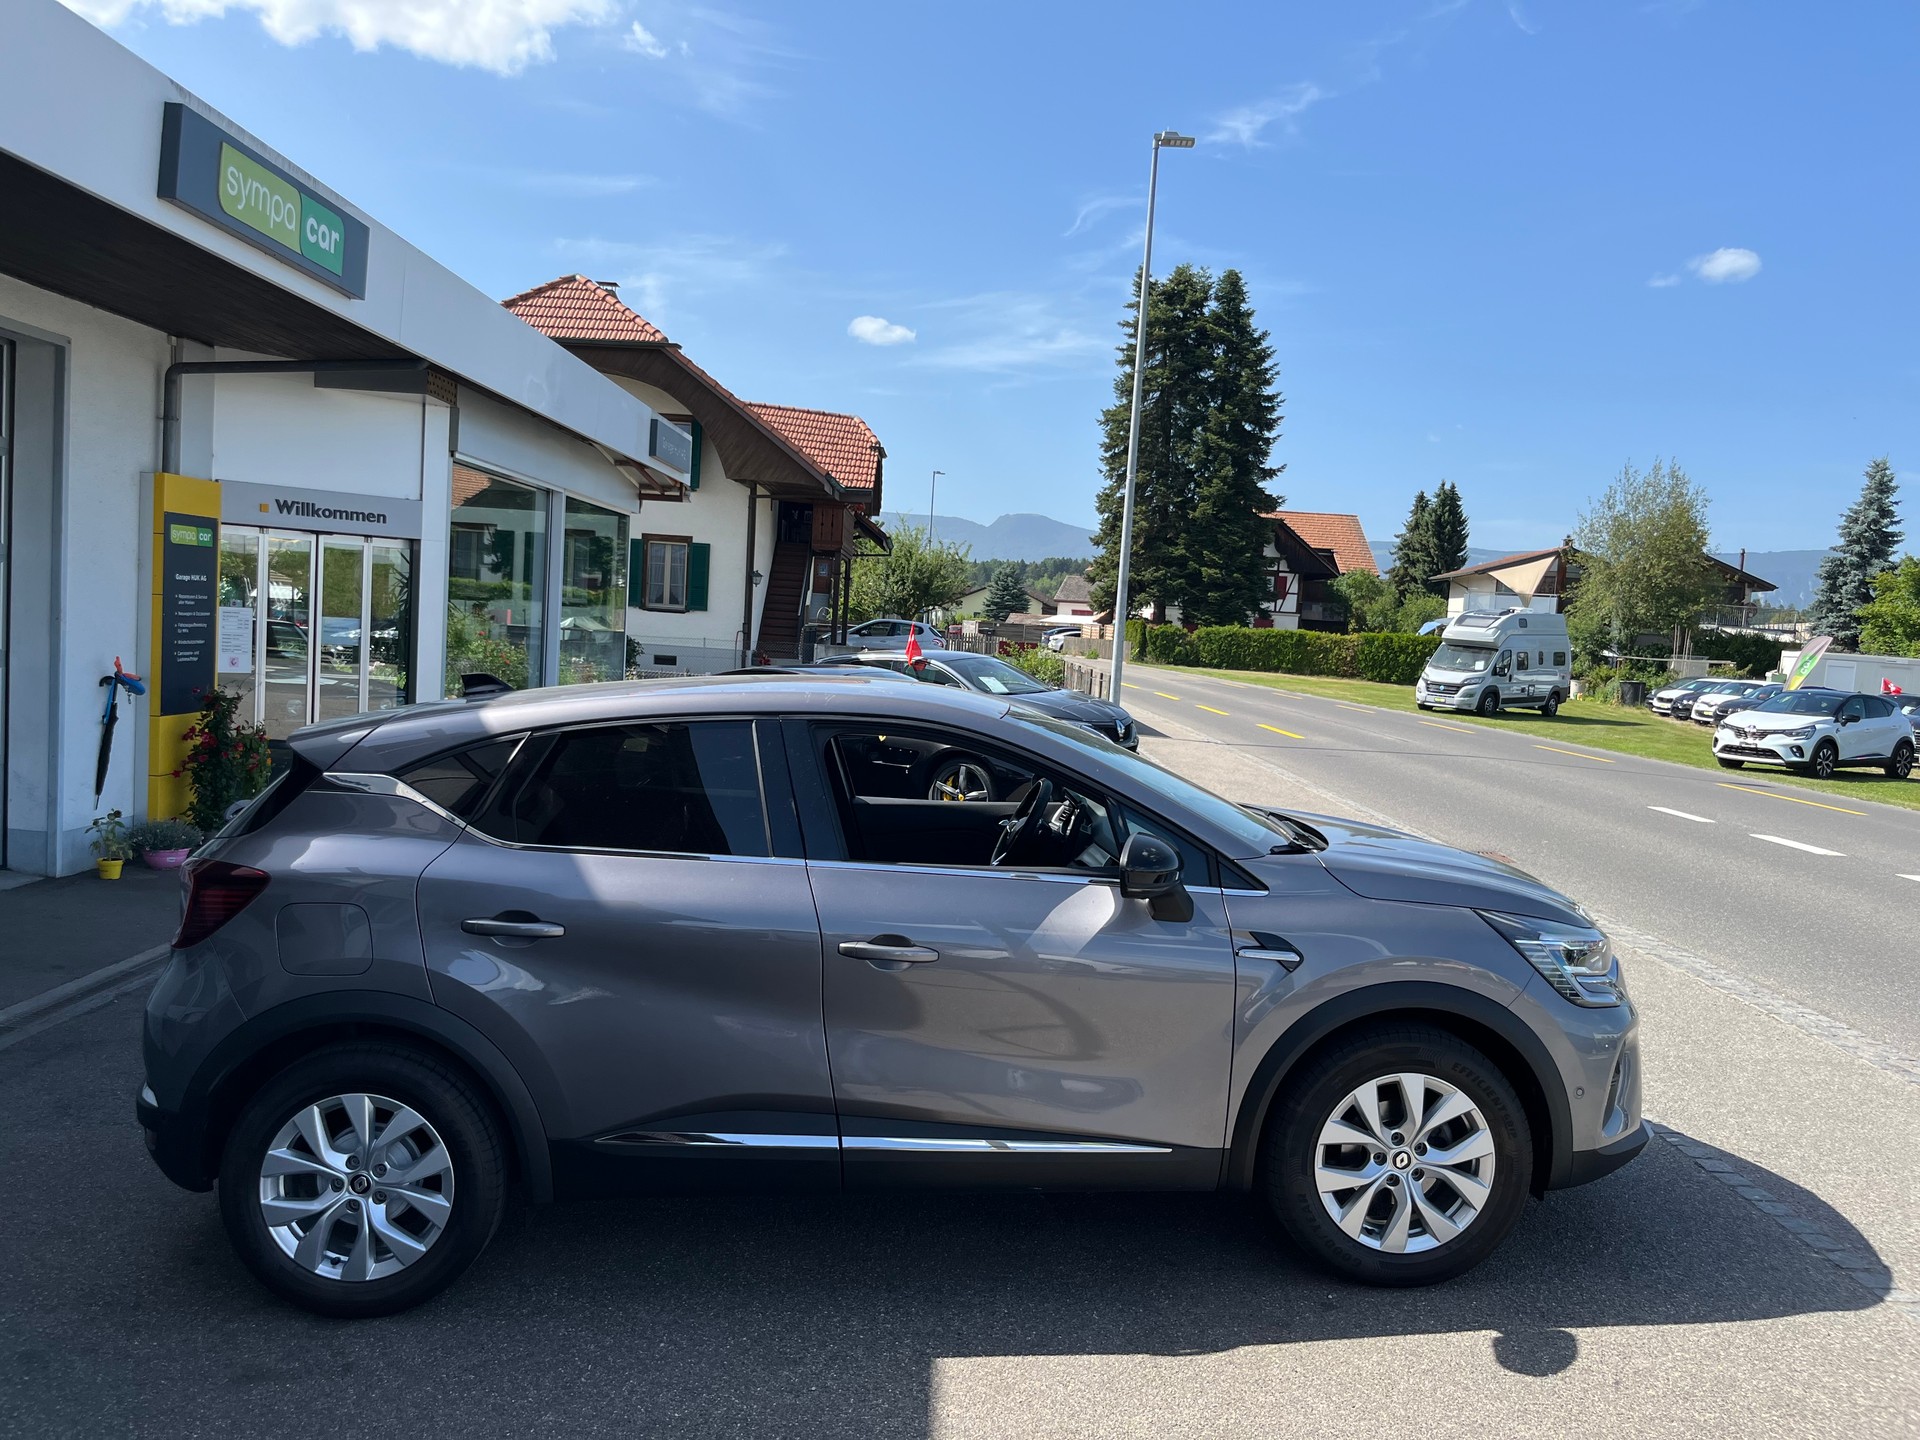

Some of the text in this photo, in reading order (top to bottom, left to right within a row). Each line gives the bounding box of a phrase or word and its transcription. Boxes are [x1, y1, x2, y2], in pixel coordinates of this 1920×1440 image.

[227, 166, 340, 254] sympa car
[275, 498, 387, 524] Willkommen
[172, 529, 212, 543] sympa car
[175, 573, 190, 582] Garage
